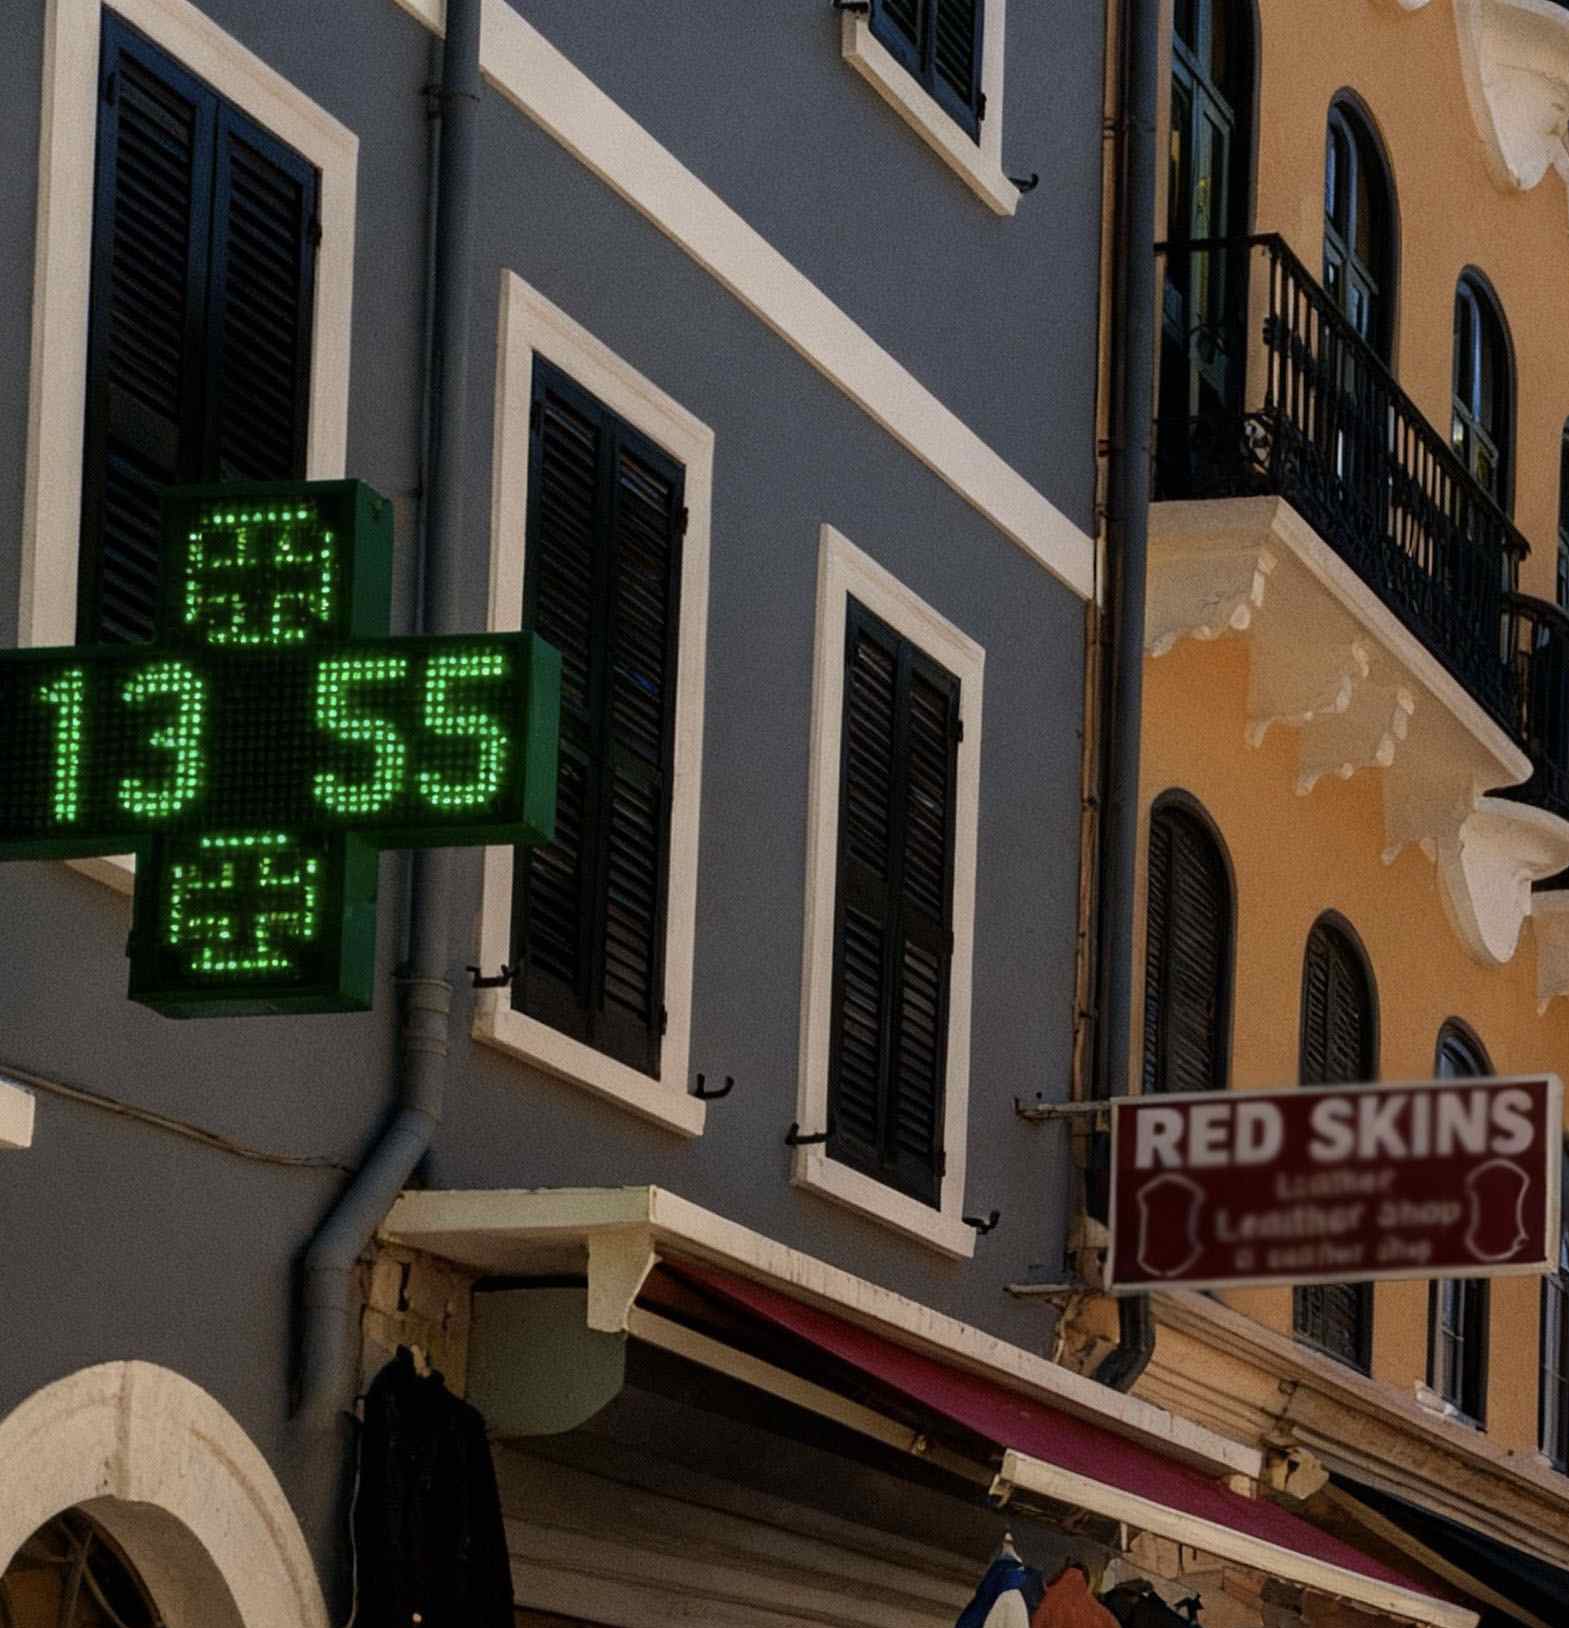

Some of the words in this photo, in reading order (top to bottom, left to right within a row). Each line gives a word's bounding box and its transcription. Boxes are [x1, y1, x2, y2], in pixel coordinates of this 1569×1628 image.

[39, 661, 208, 823] 13
[312, 653, 508, 815] 55
[1135, 1101, 1284, 1169] RED
[1307, 1088, 1536, 1163] SKINS
